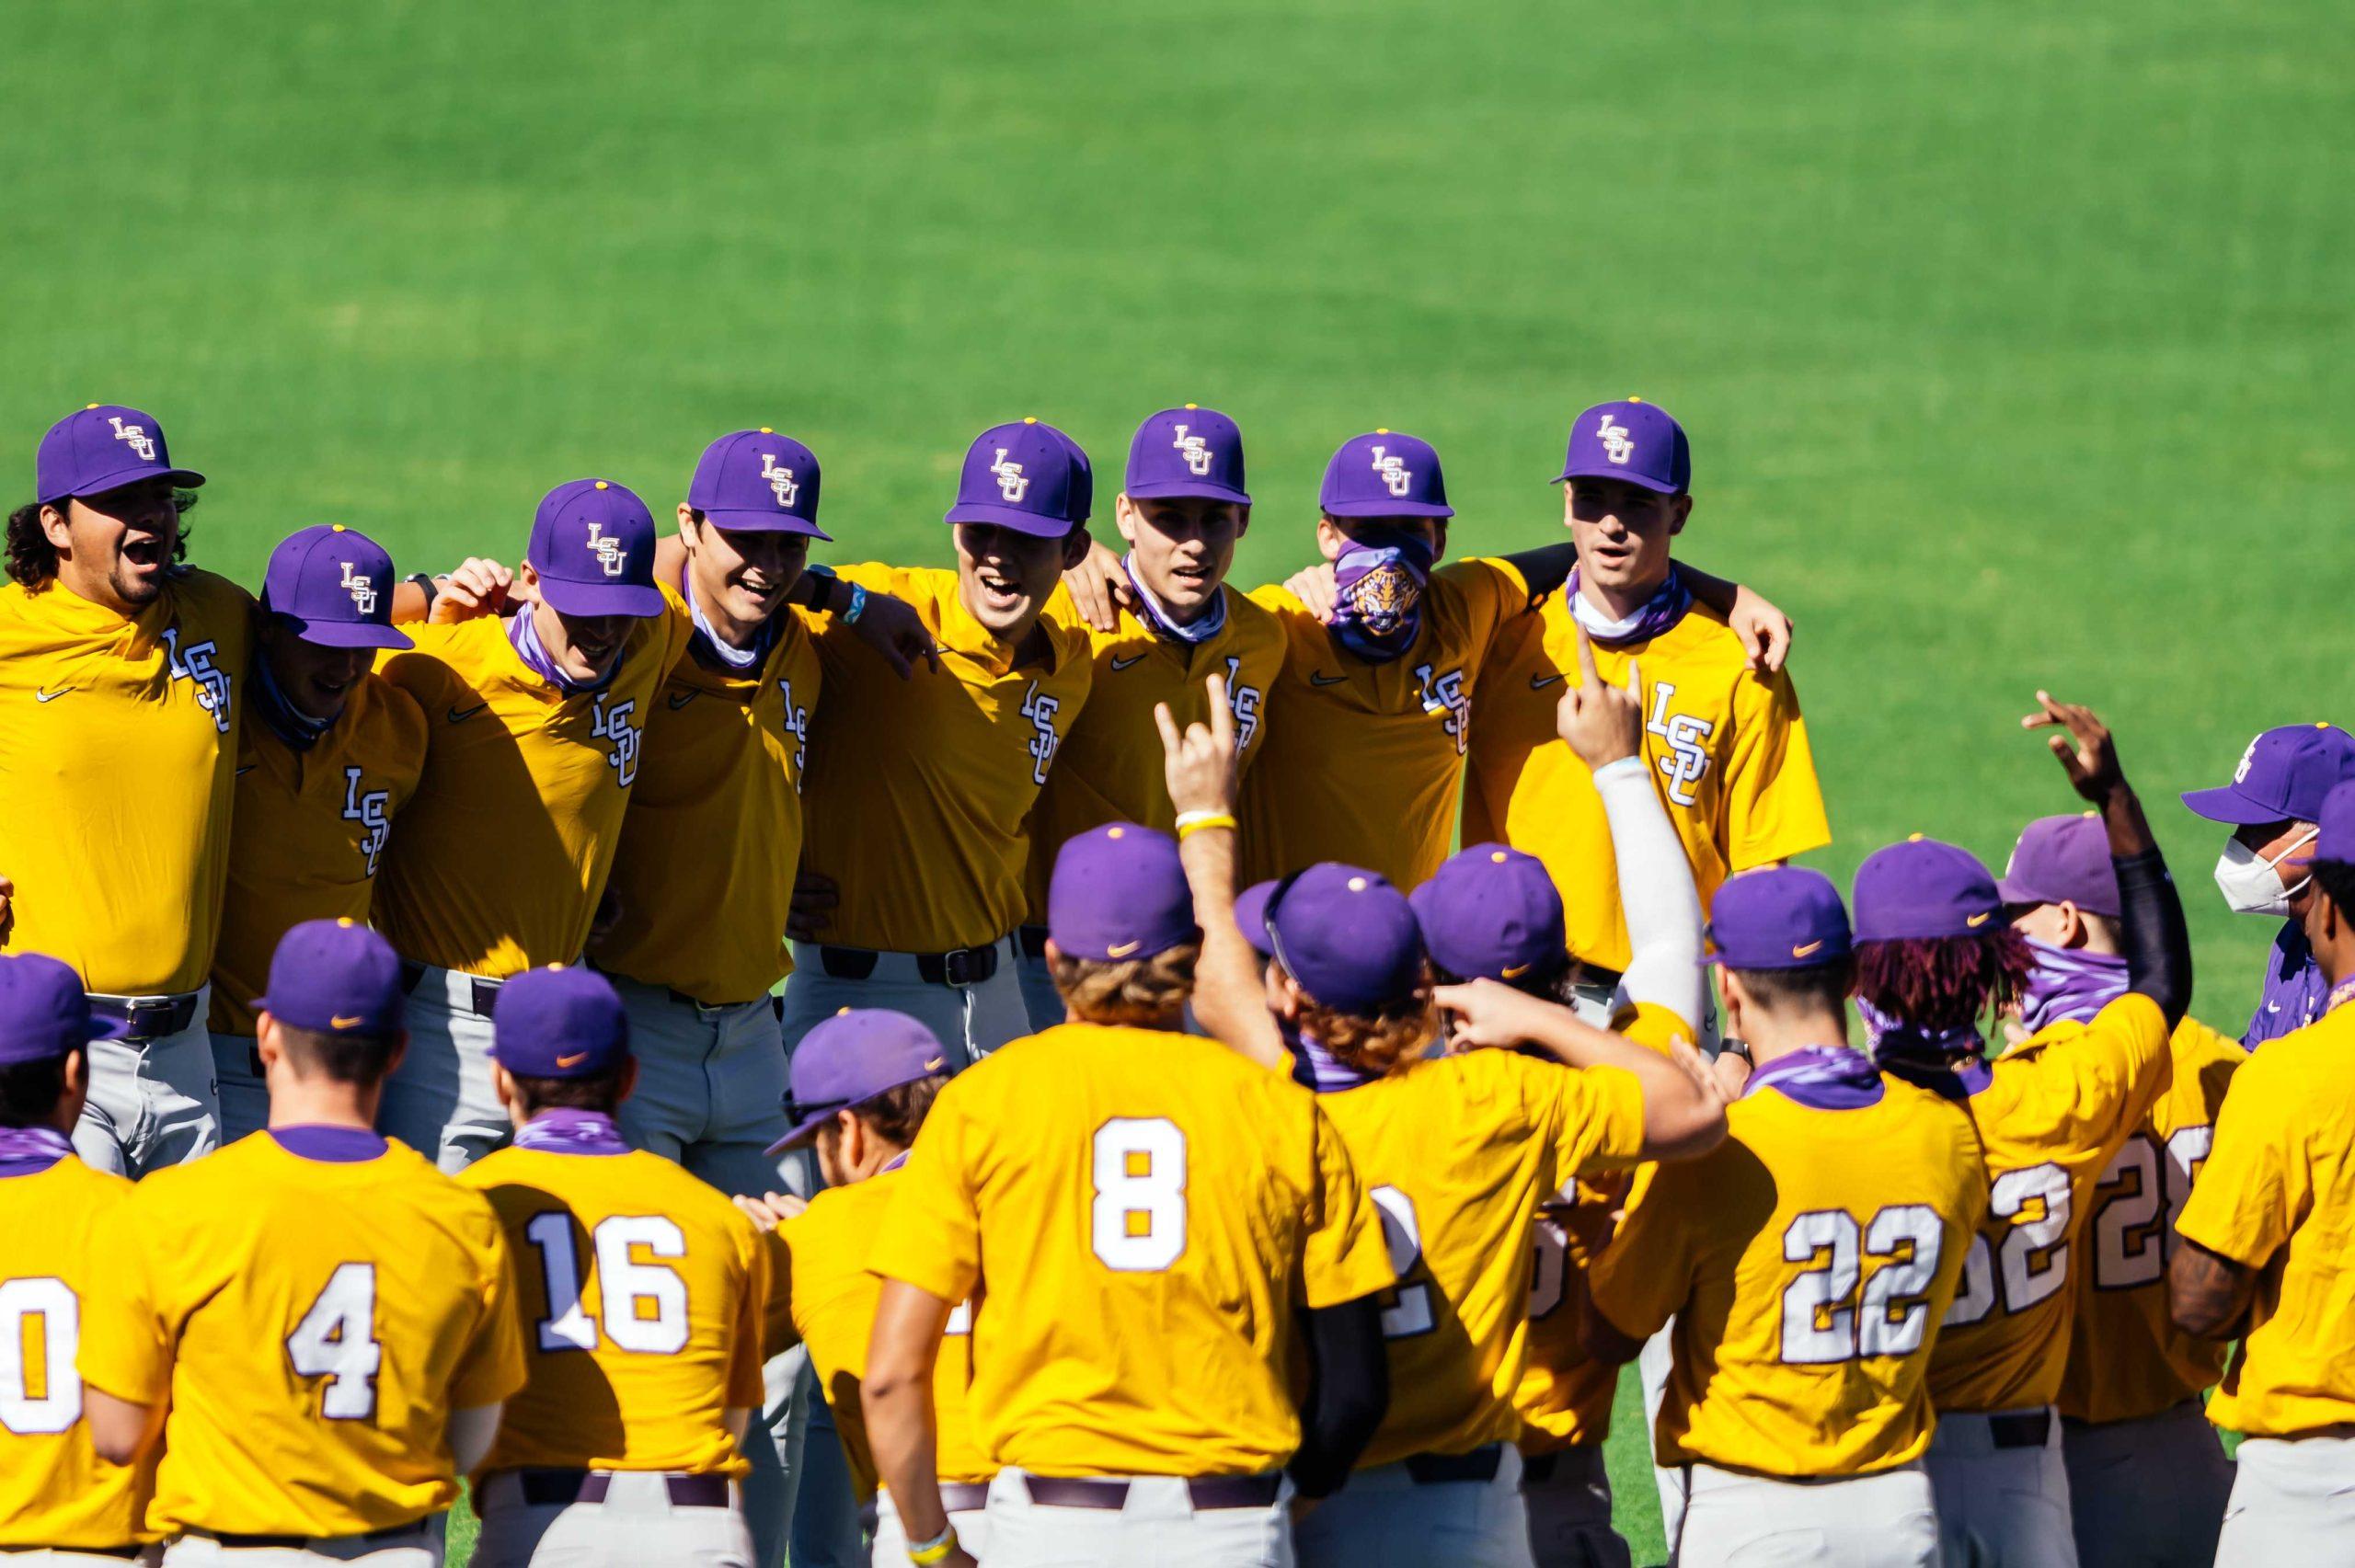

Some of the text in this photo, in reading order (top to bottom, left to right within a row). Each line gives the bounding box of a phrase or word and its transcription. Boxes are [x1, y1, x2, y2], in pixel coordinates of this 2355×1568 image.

[109, 416, 155, 460] LSU
[1174, 424, 1212, 475] LSU
[1597, 414, 1634, 464] LSU
[761, 453, 799, 508] LSU
[991, 448, 1028, 502] LSU
[1372, 446, 1412, 496] LSU
[588, 522, 627, 577] LSU
[340, 561, 378, 614] LSU
[161, 627, 232, 734] LSU
[1646, 681, 1713, 807] LSU
[1092, 1116, 1187, 1272] 8
[526, 1210, 690, 1355] 16
[1781, 1203, 1944, 1364] 22
[286, 1261, 382, 1419] 4
